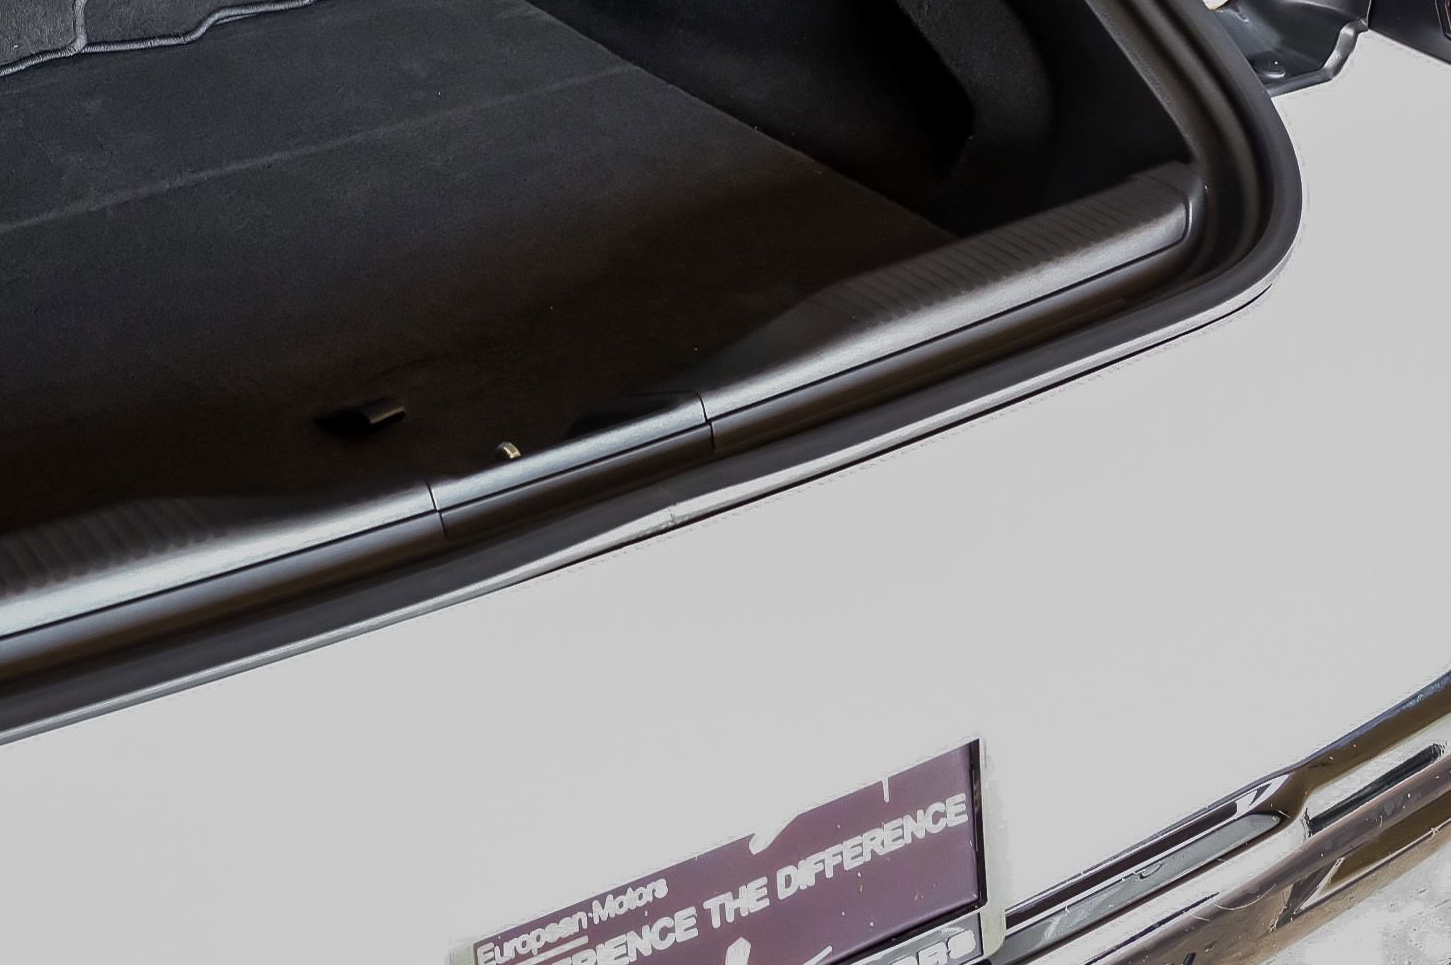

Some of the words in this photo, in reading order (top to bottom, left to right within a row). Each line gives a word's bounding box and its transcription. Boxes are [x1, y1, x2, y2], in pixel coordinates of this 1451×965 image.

[591, 878, 669, 925] Motors
[703, 876, 770, 928] THE
[776, 793, 969, 901] DIFFERENCE
